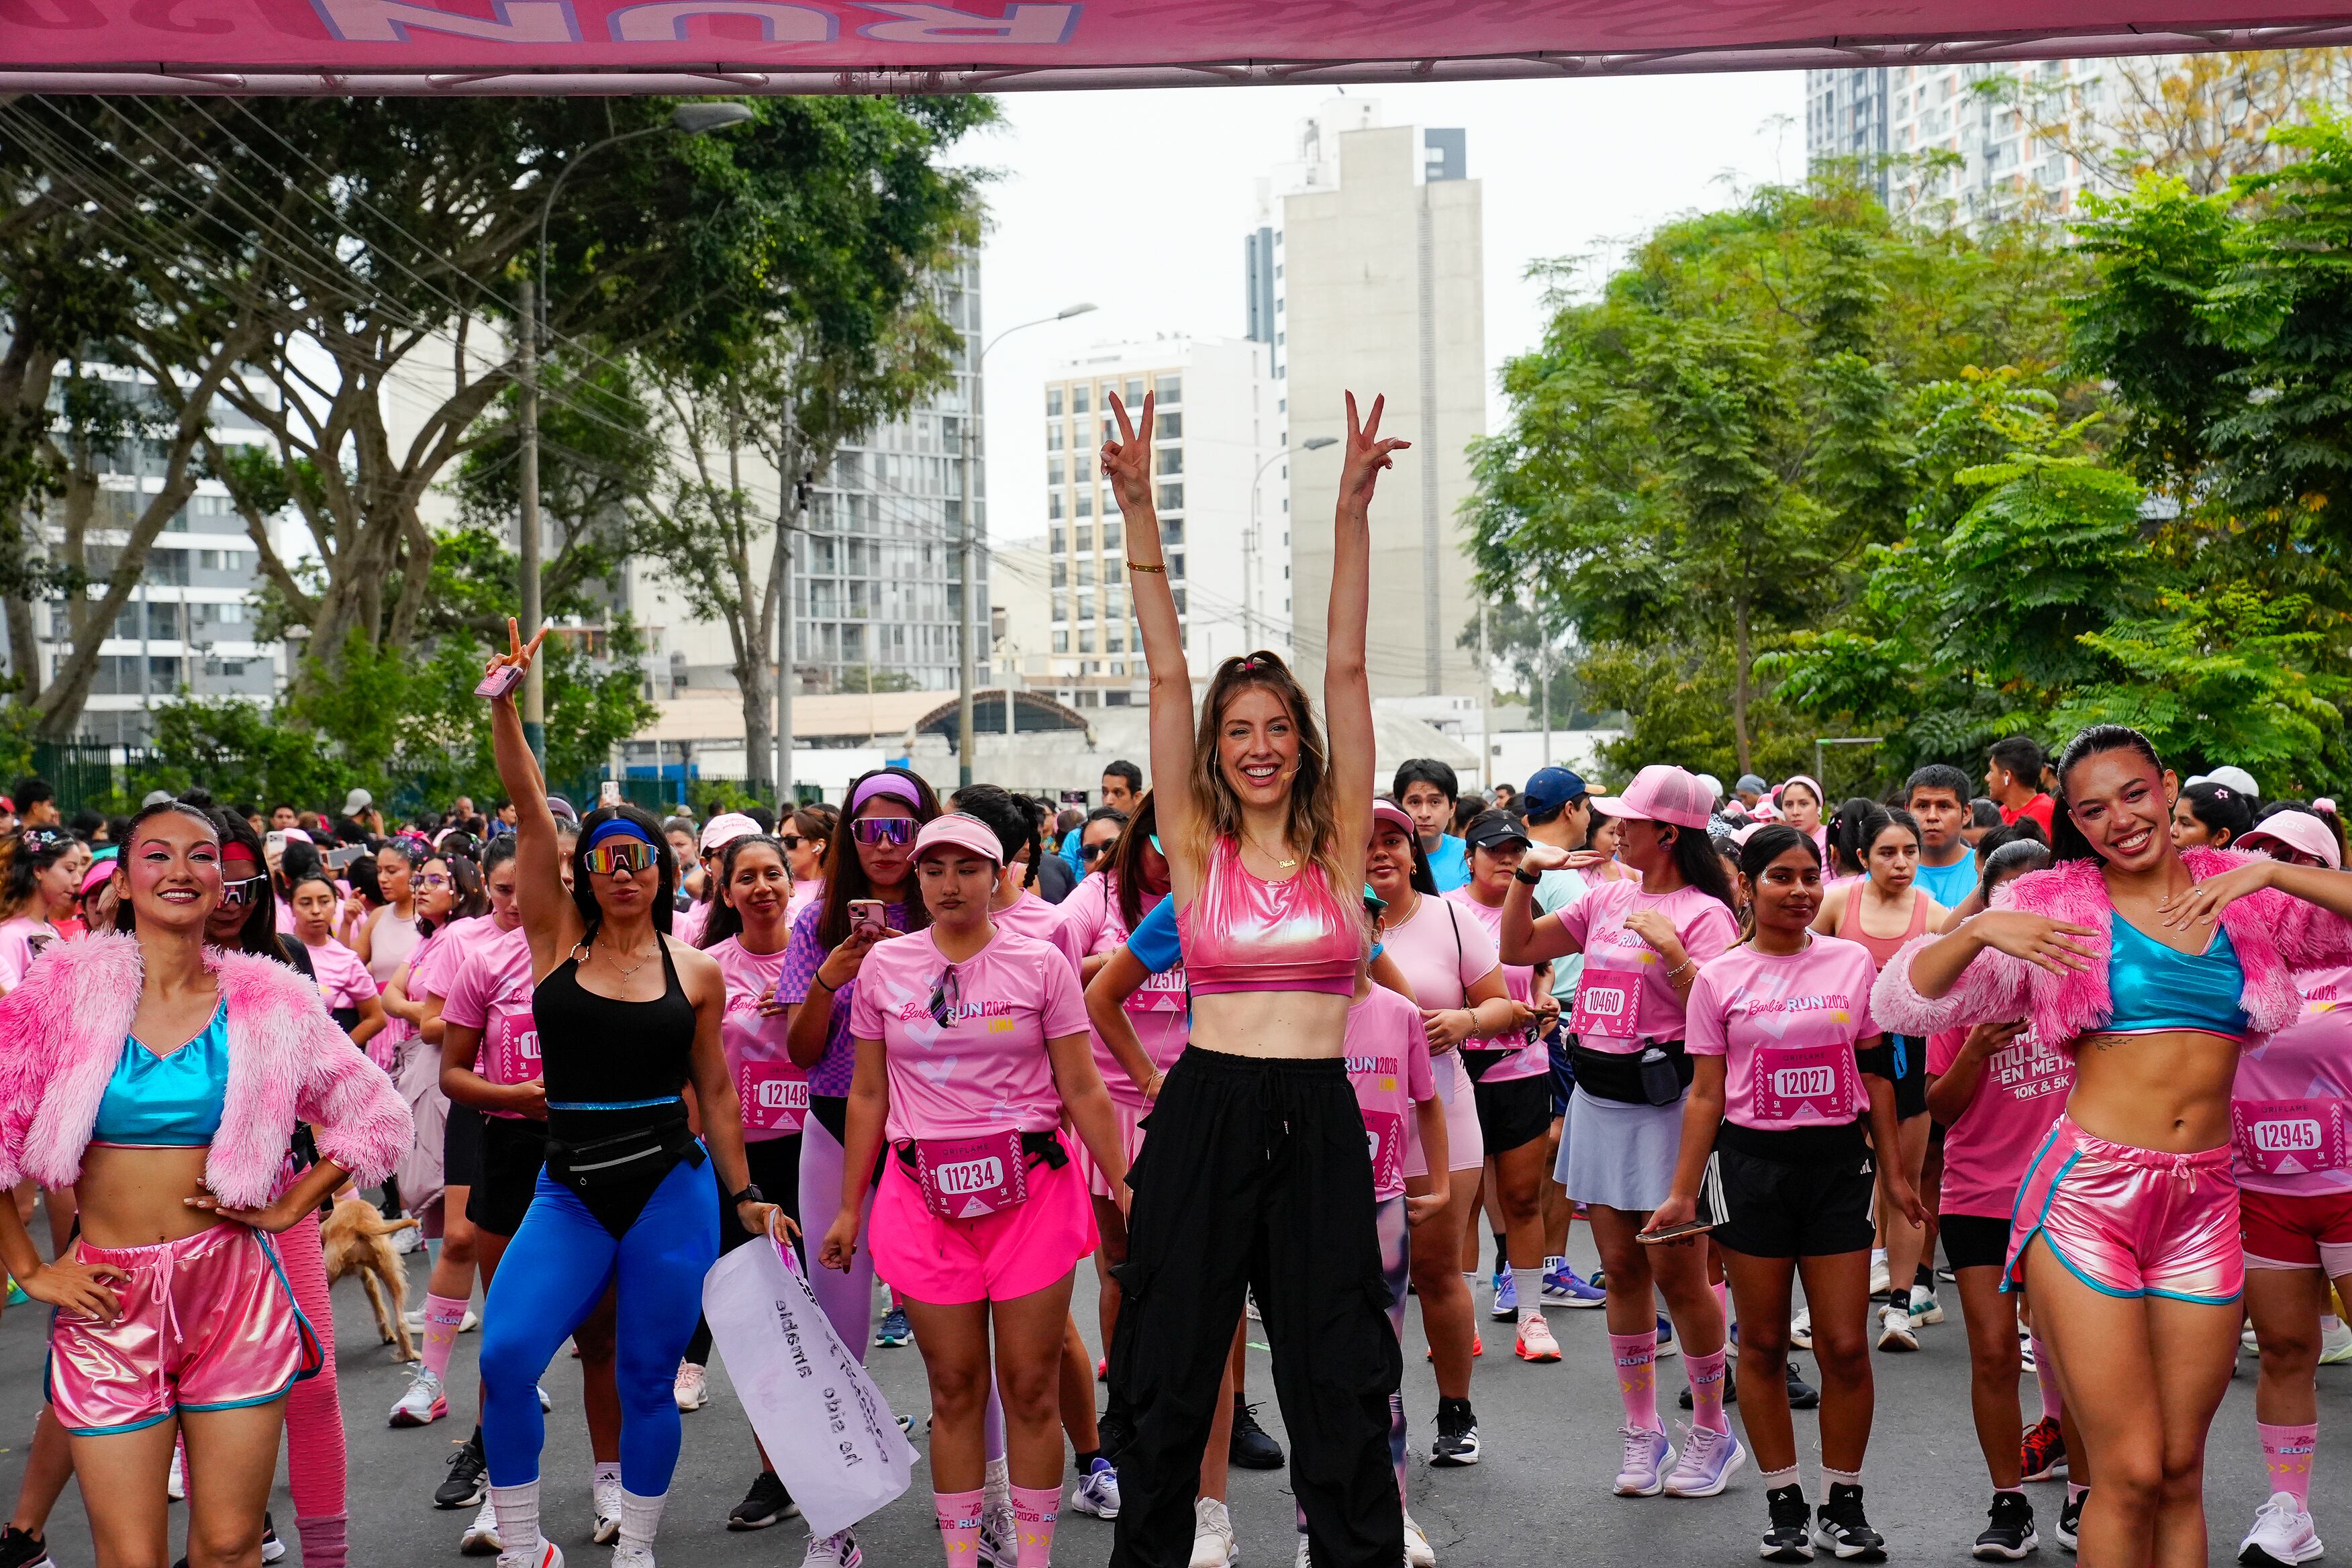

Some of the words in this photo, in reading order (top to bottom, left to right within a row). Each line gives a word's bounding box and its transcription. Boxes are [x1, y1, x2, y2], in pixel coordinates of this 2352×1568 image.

[310, 0, 1077, 43] RUN
[1591, 927, 1618, 944] Barbie
[1618, 934, 1643, 948] RUN
[729, 995, 758, 1012] Barbi
[986, 1001, 1012, 1016] 2026
[1589, 990, 1620, 1013] 10460
[1749, 999, 1785, 1016] Barbie
[1786, 995, 1826, 1012] RUN
[1826, 995, 1849, 1009] 2026
[987, 1018, 1015, 1034] LIMA
[2014, 1022, 2040, 1046] MÁ
[1783, 1052, 1825, 1061] ORIFLAME
[1344, 1056, 1379, 1074] RUN
[1379, 1057, 1398, 1075] 2026
[1781, 1069, 1828, 1095] 12027
[2001, 1065, 2024, 1085] EN
[767, 1083, 808, 1106] 12148
[2014, 1083, 2038, 1099] 10K
[2041, 1080, 2051, 1093] &
[2054, 1075, 2070, 1089] 5K
[1773, 1100, 1781, 1109] 5K
[1831, 1097, 1838, 1105] 5K
[756, 1110, 763, 1118] 5K
[2261, 1105, 2308, 1114] ORIFLAME
[2261, 1123, 2314, 1148] 12945
[942, 1143, 989, 1155] ORIFLAME
[2317, 1151, 2325, 1160] 5K
[944, 1161, 995, 1191] 11234
[1000, 1187, 1008, 1196] 5K
[940, 1197, 948, 1206] 5K
[1618, 1355, 1650, 1367] RUN
[1697, 1370, 1723, 1384] RUN
[2280, 1446, 2313, 1455] RUN
[1017, 1510, 1040, 1522] 2026
